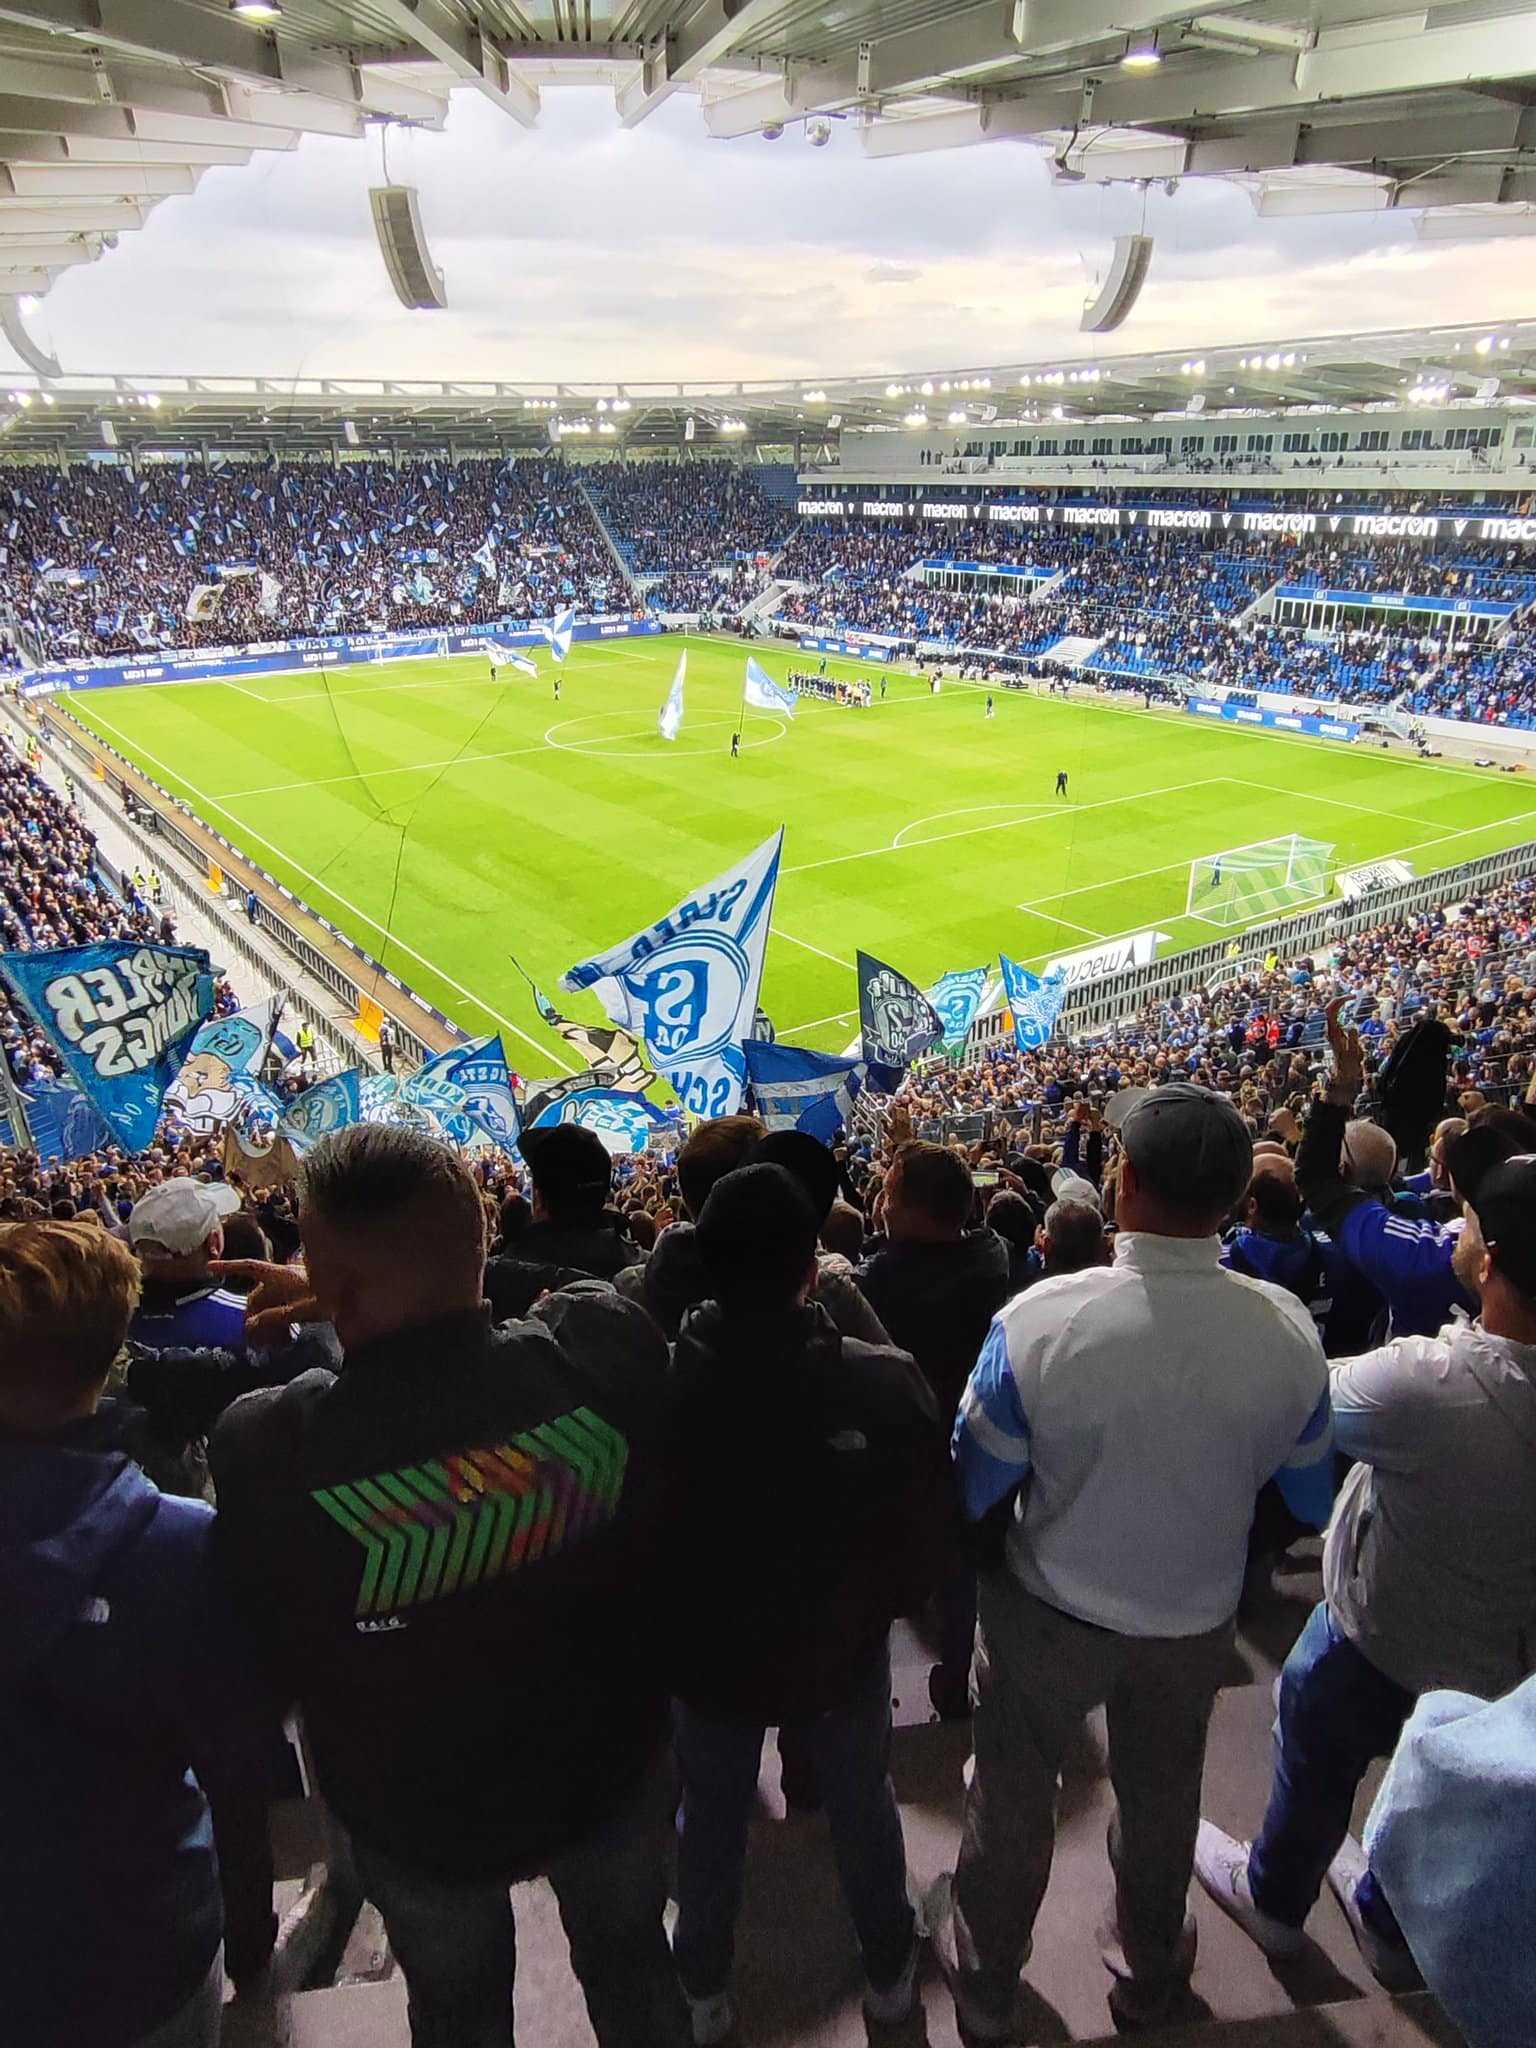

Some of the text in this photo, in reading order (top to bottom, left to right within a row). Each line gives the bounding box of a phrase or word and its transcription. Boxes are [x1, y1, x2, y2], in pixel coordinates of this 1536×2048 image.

[798, 502, 843, 515] macron
[864, 502, 903, 516] macron
[923, 503, 967, 518] macron
[990, 505, 1038, 521] macron
[1064, 508, 1119, 524] macron
[1148, 510, 1211, 528] macron
[1243, 513, 1316, 532] macron
[1353, 515, 1438, 537] macron
